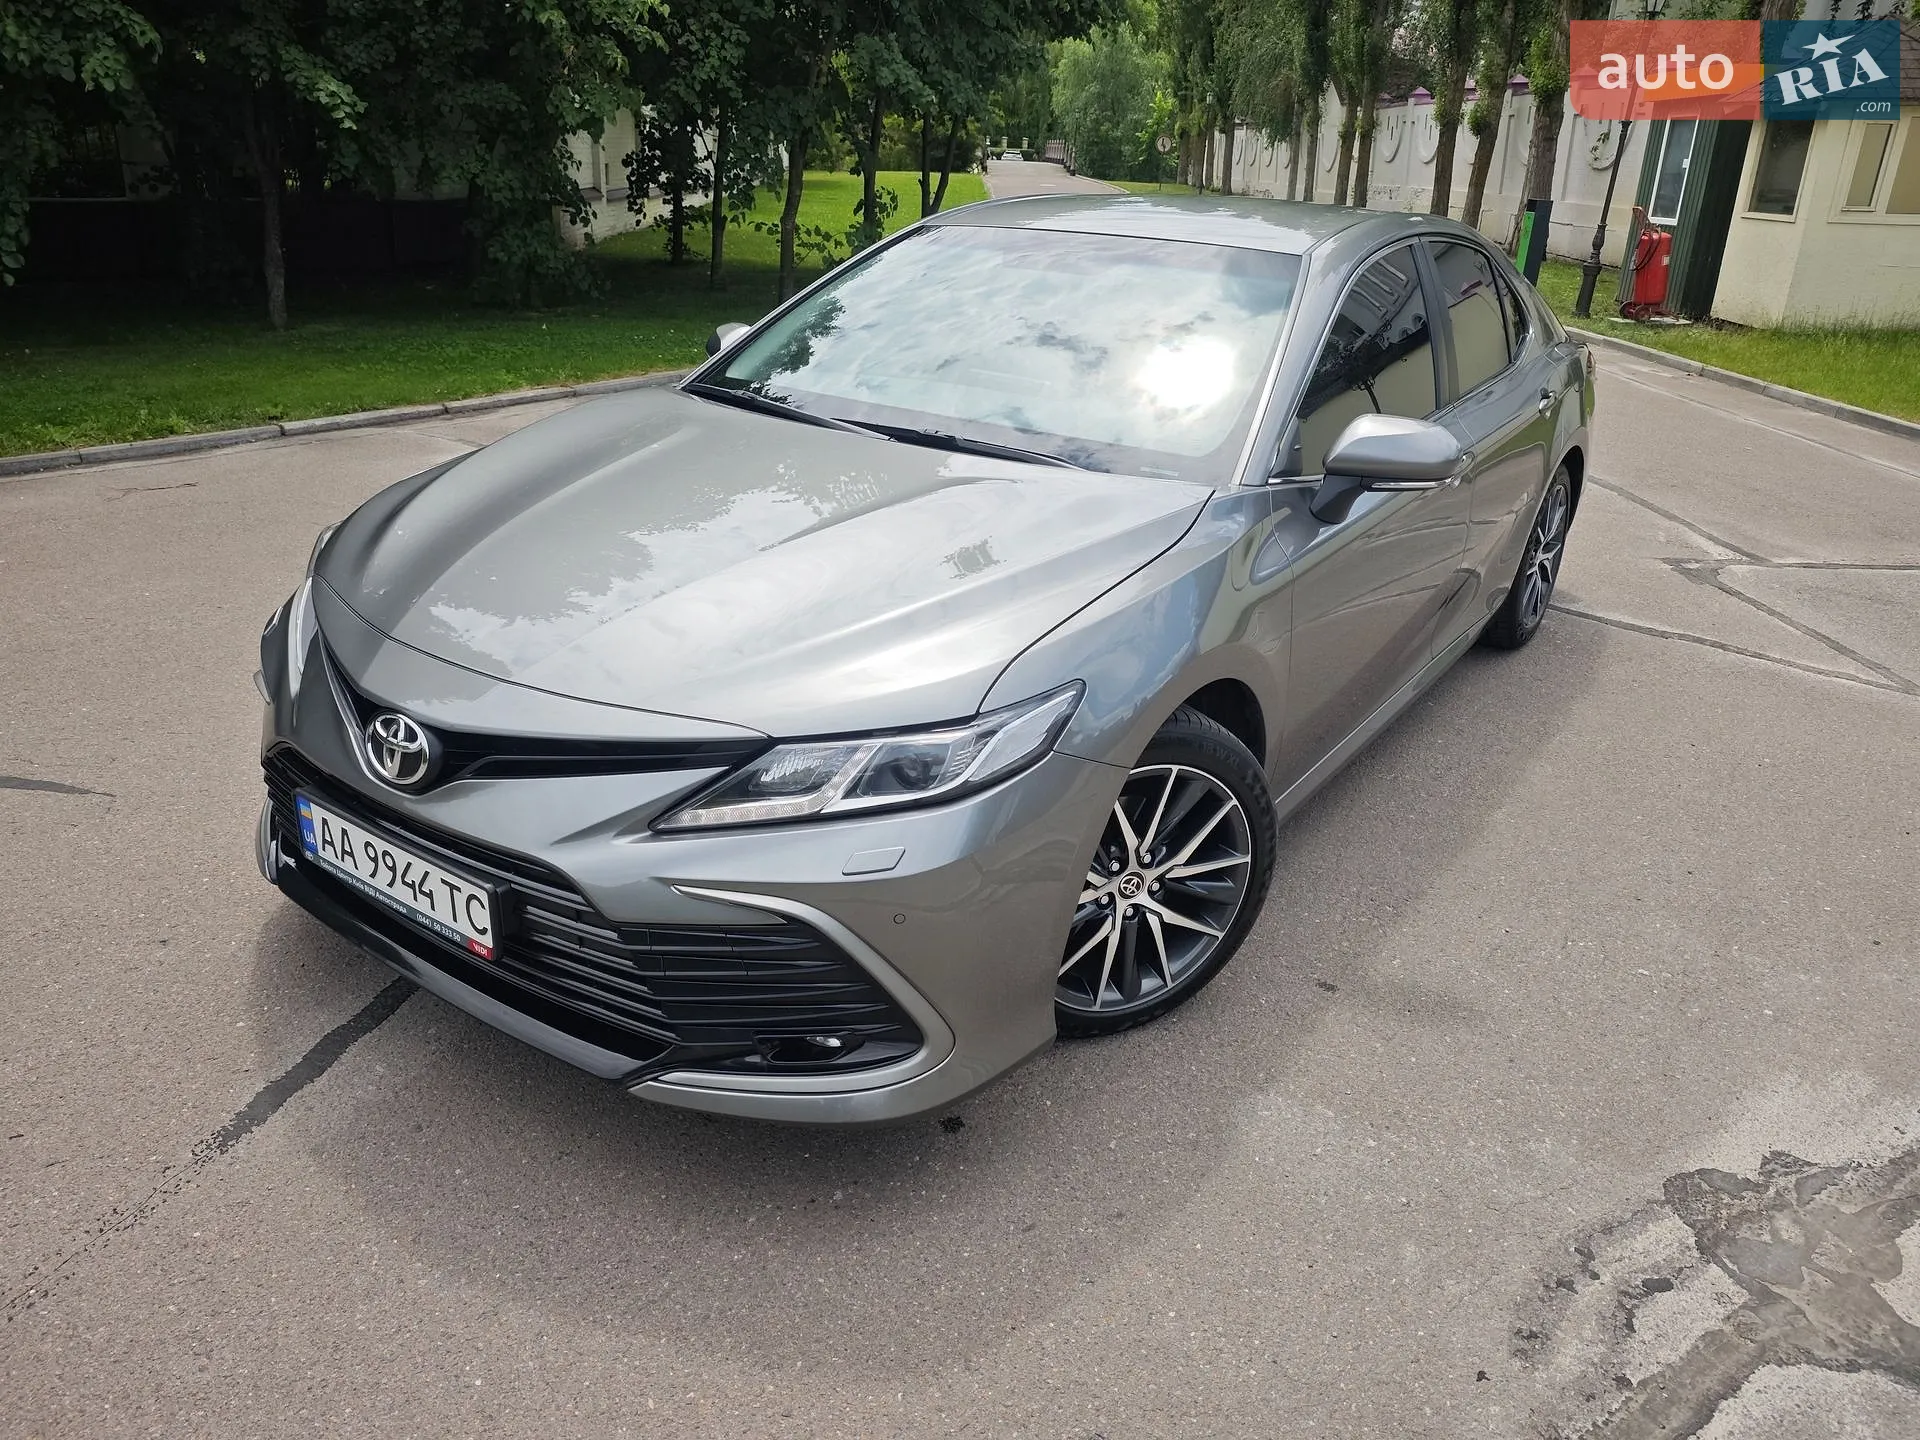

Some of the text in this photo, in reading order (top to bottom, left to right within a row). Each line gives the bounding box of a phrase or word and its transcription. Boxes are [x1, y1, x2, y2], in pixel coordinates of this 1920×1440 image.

[303, 829, 316, 845] UA
[321, 816, 489, 936] AA 9944 TC
[416, 913, 432, 927] (044)
[433, 922, 441, 932] 50
